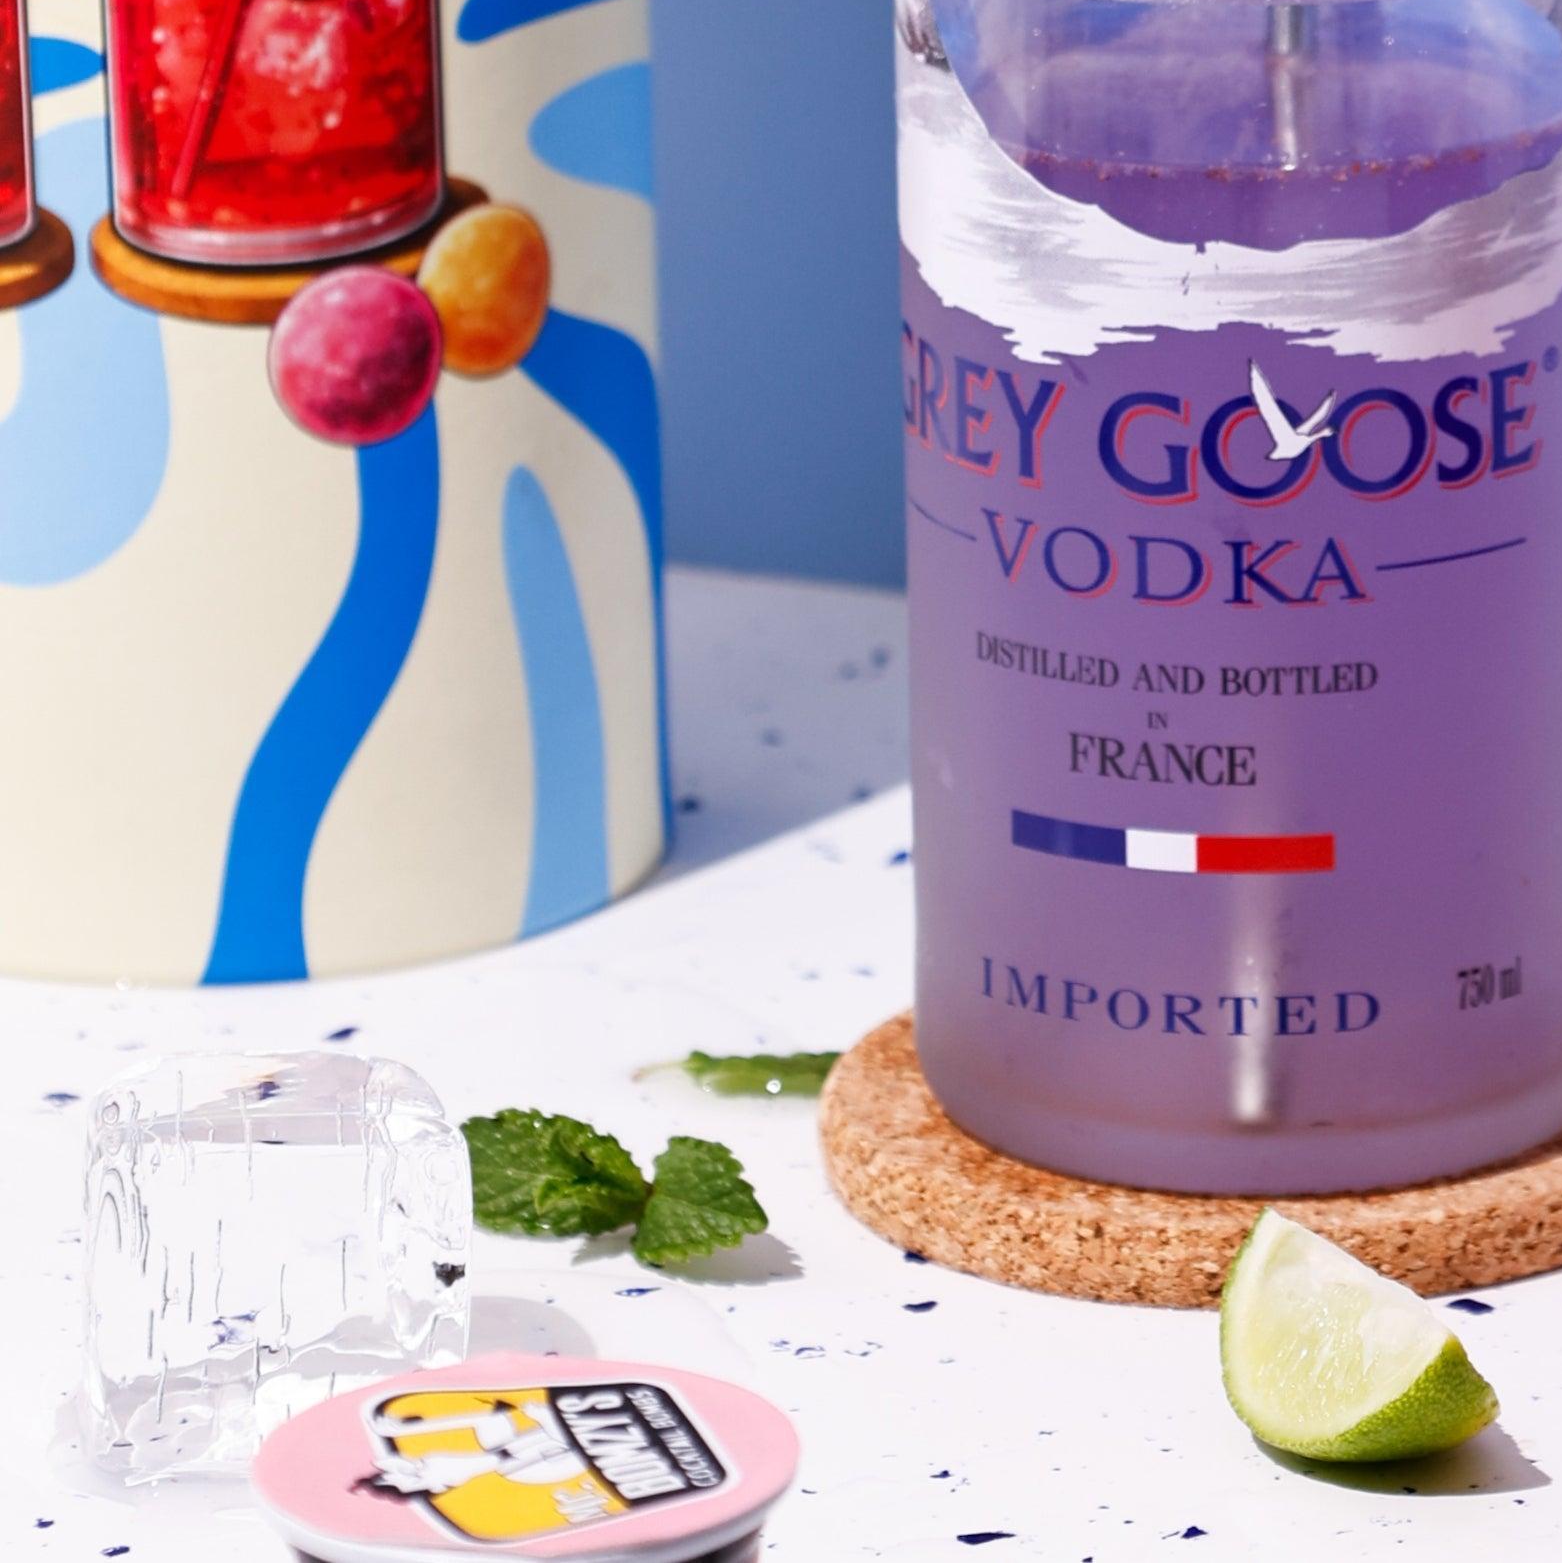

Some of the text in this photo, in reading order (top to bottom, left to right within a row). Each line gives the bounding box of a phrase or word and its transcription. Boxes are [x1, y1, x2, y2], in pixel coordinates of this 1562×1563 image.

[980, 507, 1374, 608] VODKA
[976, 631, 1379, 697] DISTILLED AND BOTTLED
[1147, 711, 1169, 731] IN
[1068, 732, 1258, 787] FRANCE
[980, 956, 1382, 1037] IMPORTED
[1457, 963, 1495, 1011] 750
